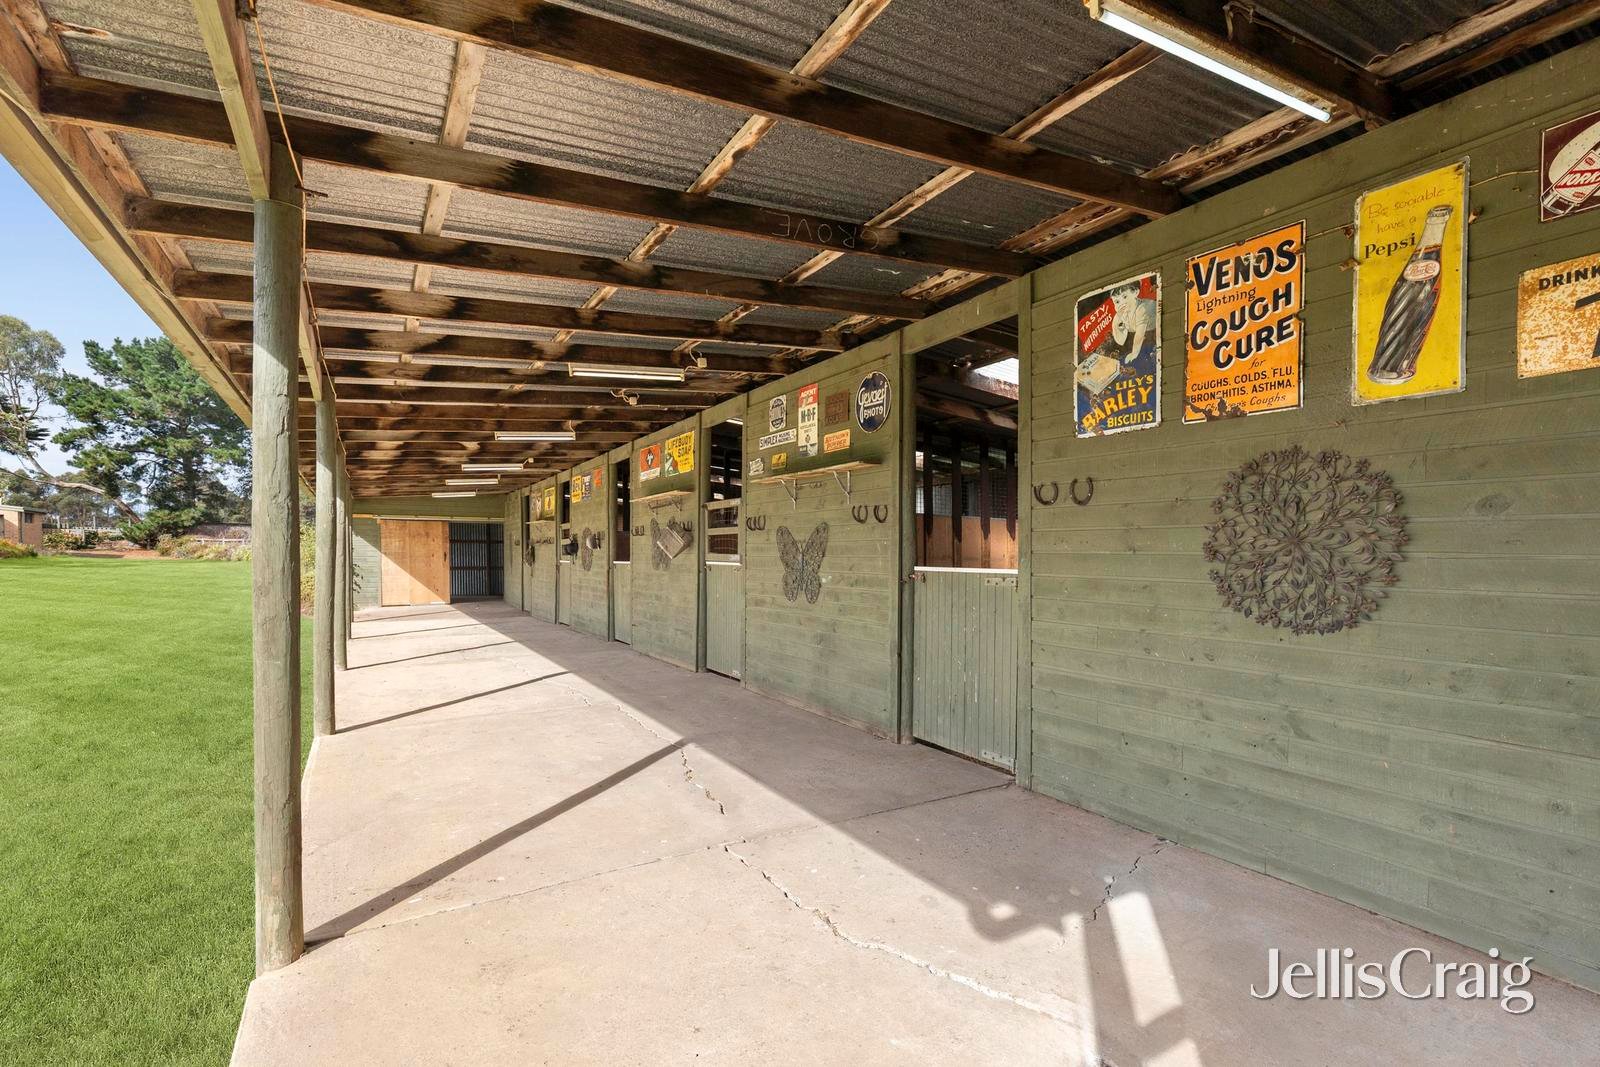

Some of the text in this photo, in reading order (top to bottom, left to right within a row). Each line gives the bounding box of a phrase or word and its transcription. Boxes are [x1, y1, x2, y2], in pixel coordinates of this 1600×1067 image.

[1365, 232, 1416, 259] Pepsi
[1192, 239, 1298, 297] VENOS
[1538, 265, 1600, 291] DRINK
[1196, 286, 1257, 315] Lightning
[1191, 281, 1294, 351] COUGH
[1083, 313, 1113, 351] NUTRITIOUS
[1213, 314, 1297, 370] CURE
[1248, 358, 1265, 370] for
[1082, 386, 1153, 431] BARLEY
[1249, 392, 1287, 407] Coughs
[1107, 410, 1153, 428] BISCUITS
